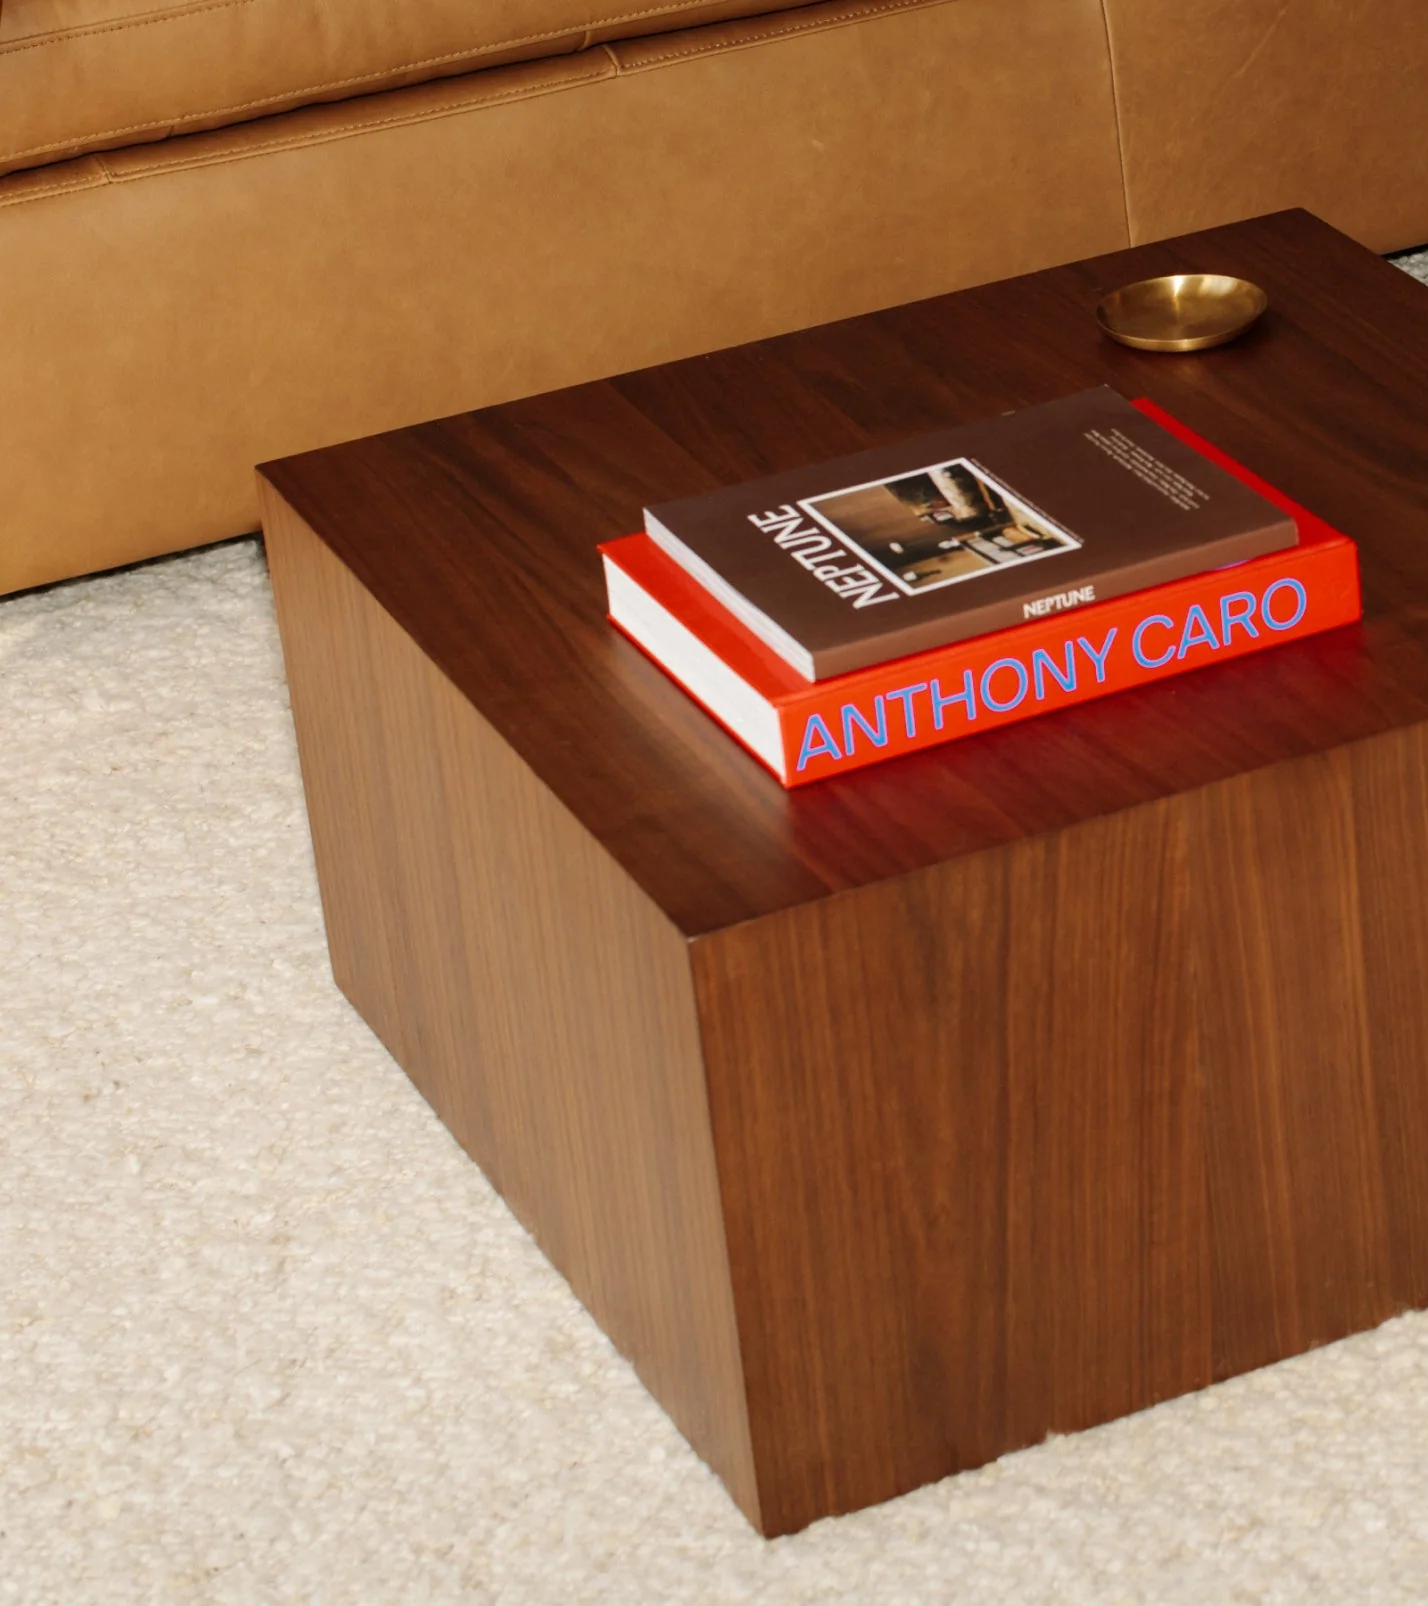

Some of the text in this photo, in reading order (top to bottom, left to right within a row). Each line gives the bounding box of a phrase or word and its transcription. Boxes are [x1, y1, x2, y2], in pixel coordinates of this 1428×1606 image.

[747, 503, 900, 609] NEPTUNE
[1022, 585, 1096, 619] NEPTUNE
[796, 577, 1308, 771] ANTHONY CARO
